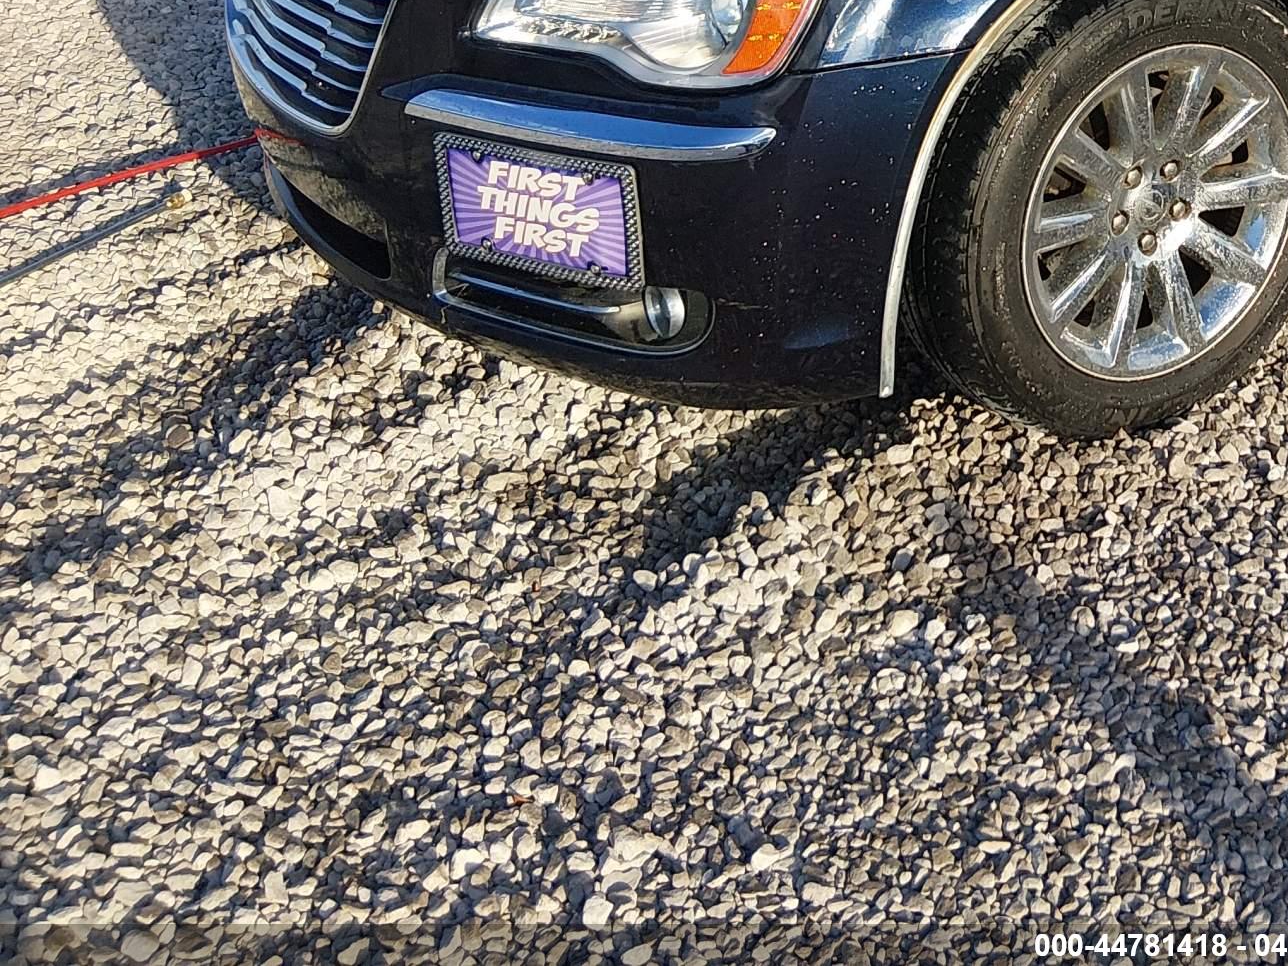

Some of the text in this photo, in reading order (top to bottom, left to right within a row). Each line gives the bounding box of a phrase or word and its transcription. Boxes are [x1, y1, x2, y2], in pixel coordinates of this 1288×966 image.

[487, 160, 585, 202] FIRST
[477, 185, 600, 233] THINGS
[494, 216, 590, 258] FIRST
